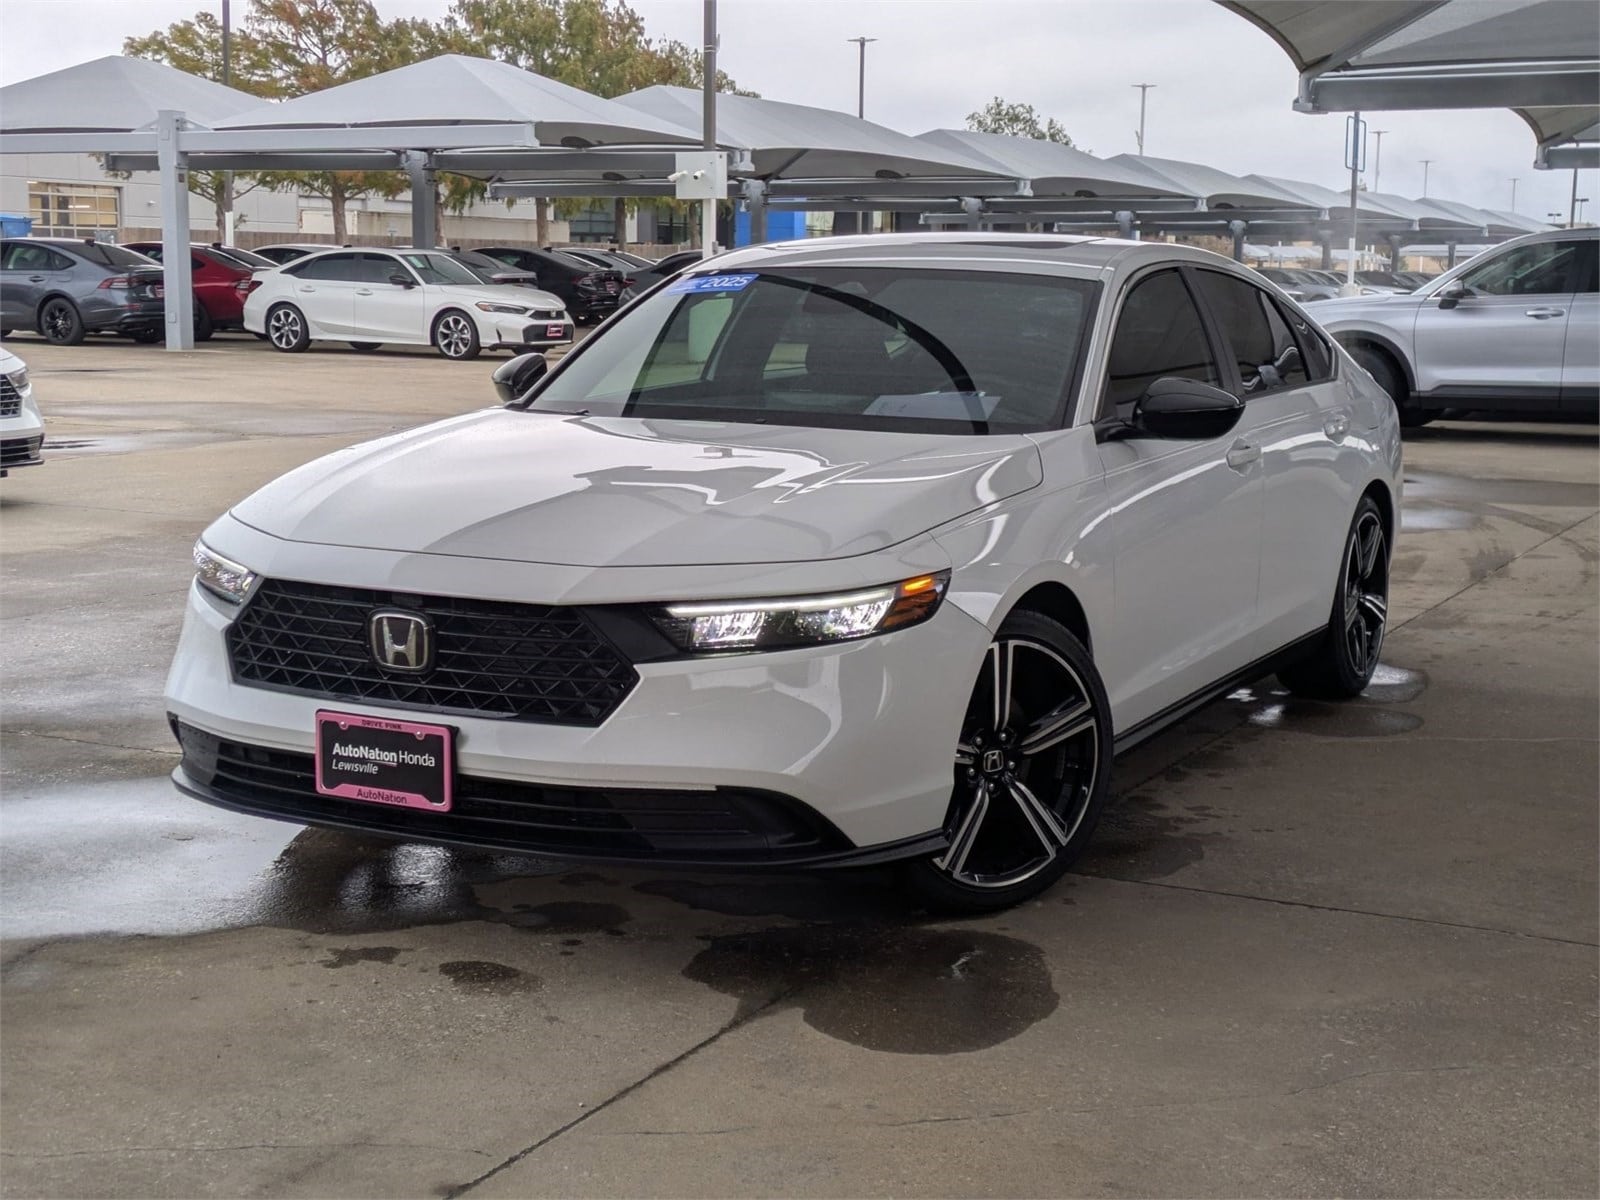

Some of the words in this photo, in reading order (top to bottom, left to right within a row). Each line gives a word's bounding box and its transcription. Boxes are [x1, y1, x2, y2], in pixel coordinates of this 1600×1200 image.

[700, 276, 753, 289] 2025
[332, 742, 397, 763] AutoNation
[399, 750, 436, 767] Honda
[332, 759, 379, 775] Lewisville
[356, 788, 408, 804] AutoNation
